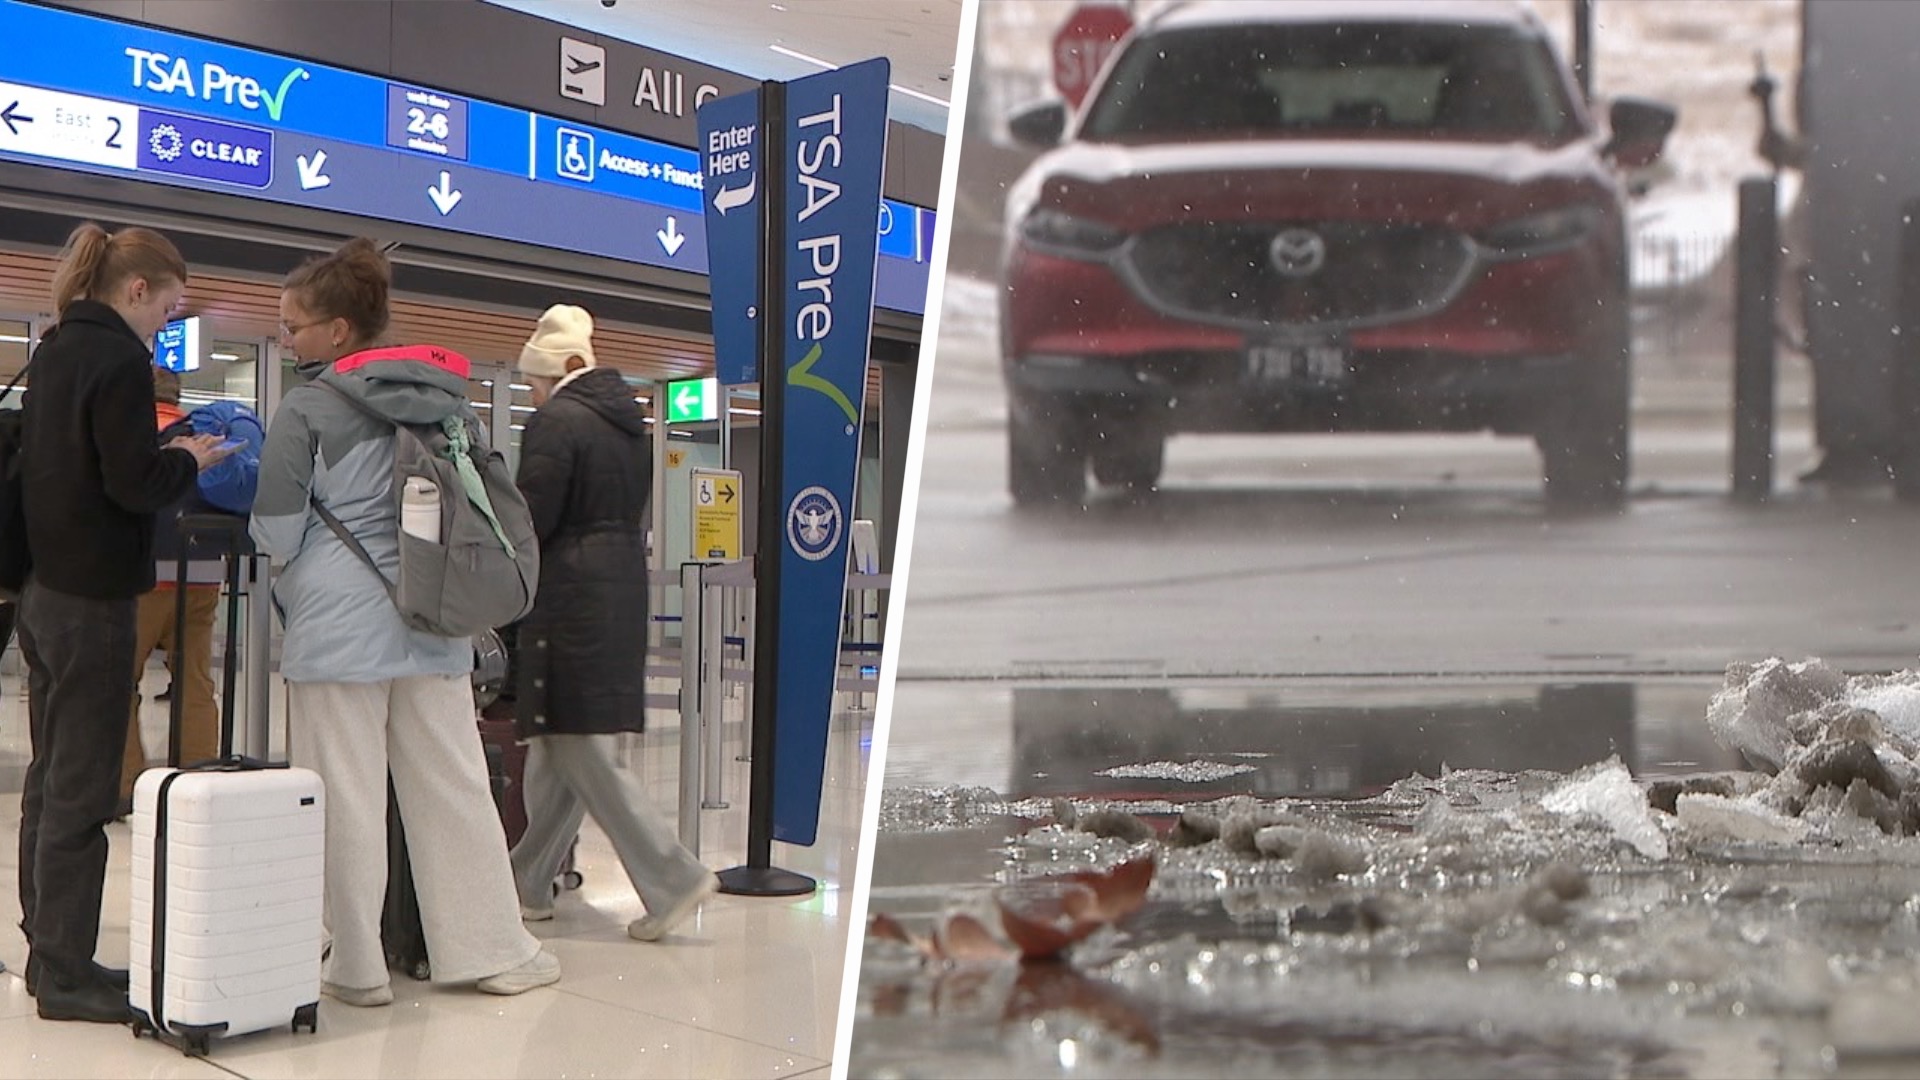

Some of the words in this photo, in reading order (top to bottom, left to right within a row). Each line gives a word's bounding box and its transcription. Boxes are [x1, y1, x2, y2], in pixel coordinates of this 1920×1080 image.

[125, 46, 197, 98] TSA
[202, 62, 260, 109] Pre
[634, 67, 683, 117] All
[55, 107, 92, 129] East
[105, 116, 122, 149] 2
[406, 106, 449, 139] 2-6
[190, 139, 262, 167] CLEAR
[709, 124, 756, 154] Enter
[599, 148, 650, 178] Access
[709, 150, 751, 177] Here
[797, 93, 842, 223] TSA
[796, 234, 841, 341] Pre
